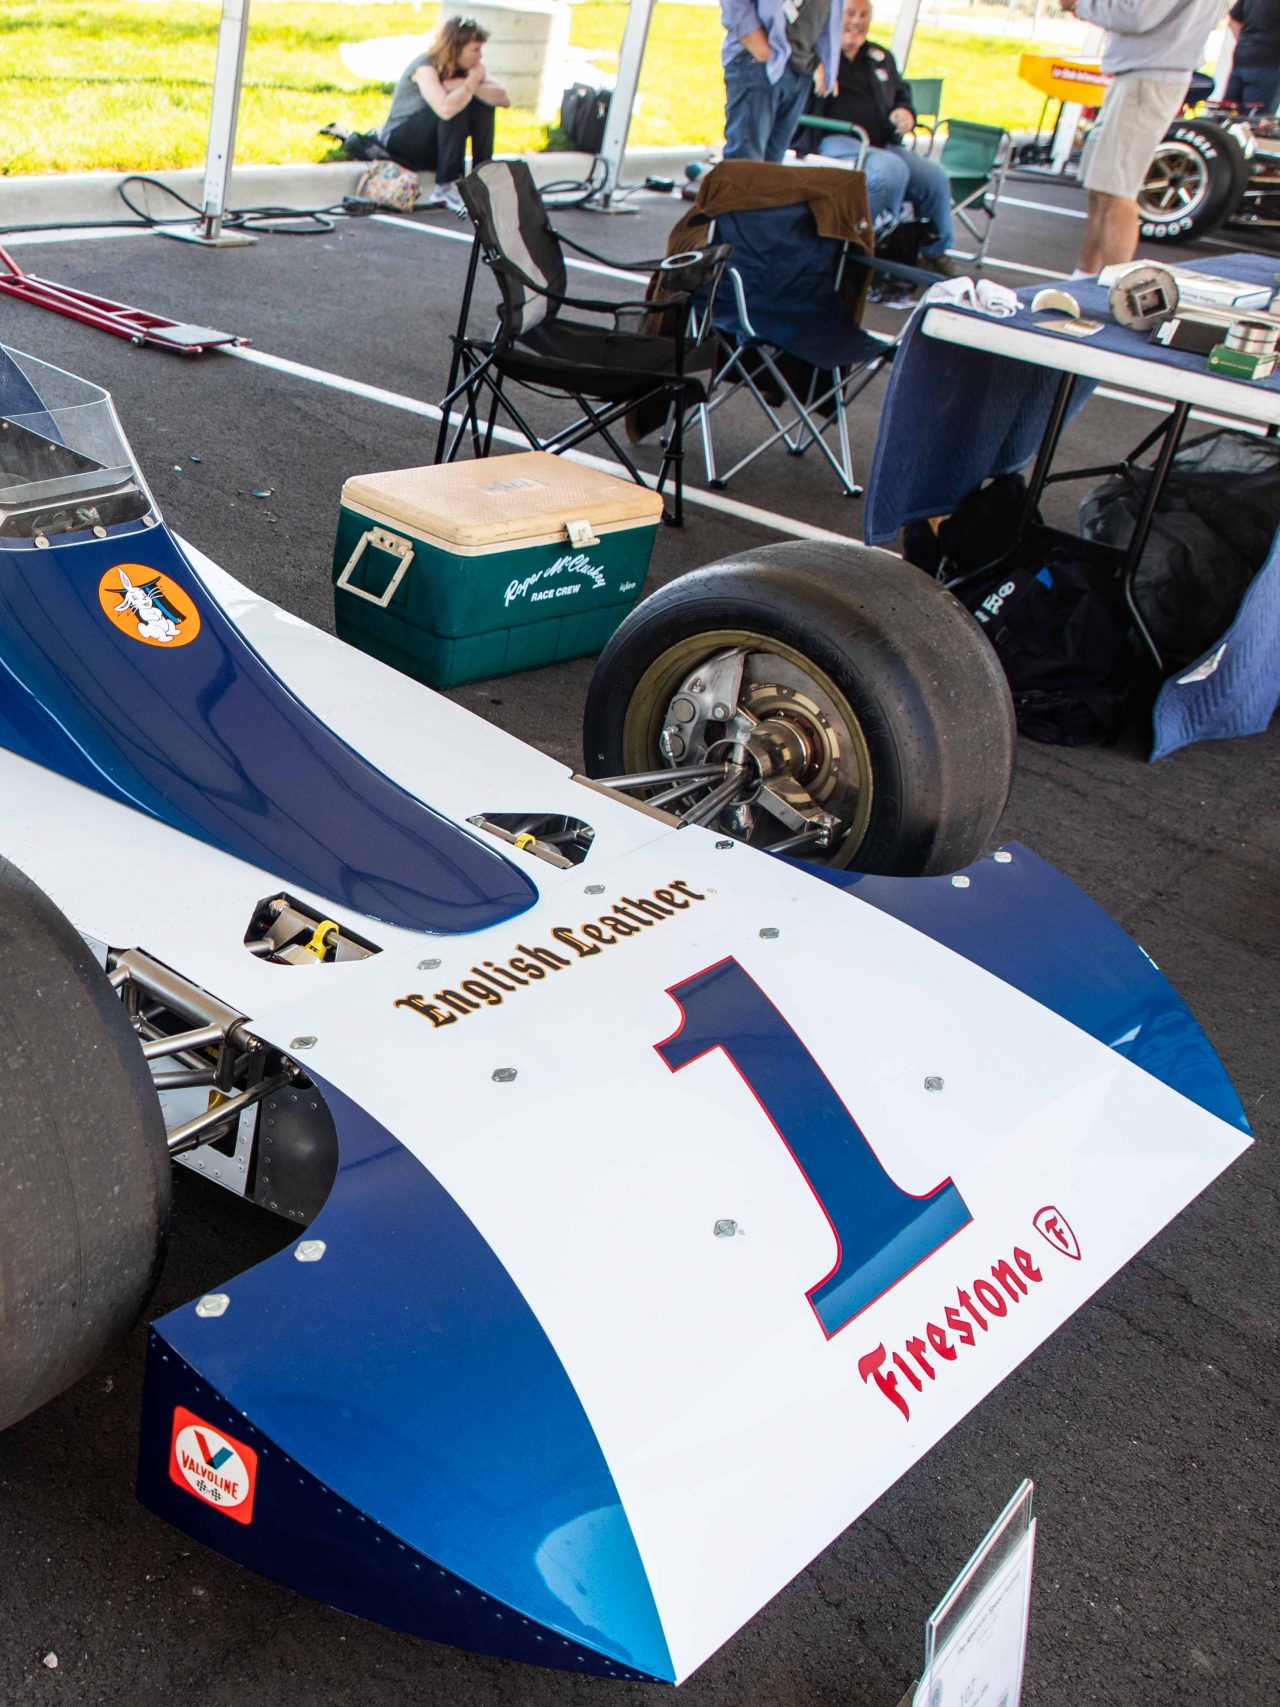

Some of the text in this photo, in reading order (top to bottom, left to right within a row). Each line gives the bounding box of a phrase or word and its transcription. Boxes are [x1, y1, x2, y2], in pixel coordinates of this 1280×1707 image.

[1175, 127, 1218, 160] EAGLE
[504, 570, 544, 607] Roger
[531, 584, 581, 602] RACE CREW
[393, 879, 707, 1028] English Leather
[652, 954, 975, 1342] 1
[858, 1245, 1044, 1423] Firestone
[181, 1449, 239, 1501] VALVOLINE
